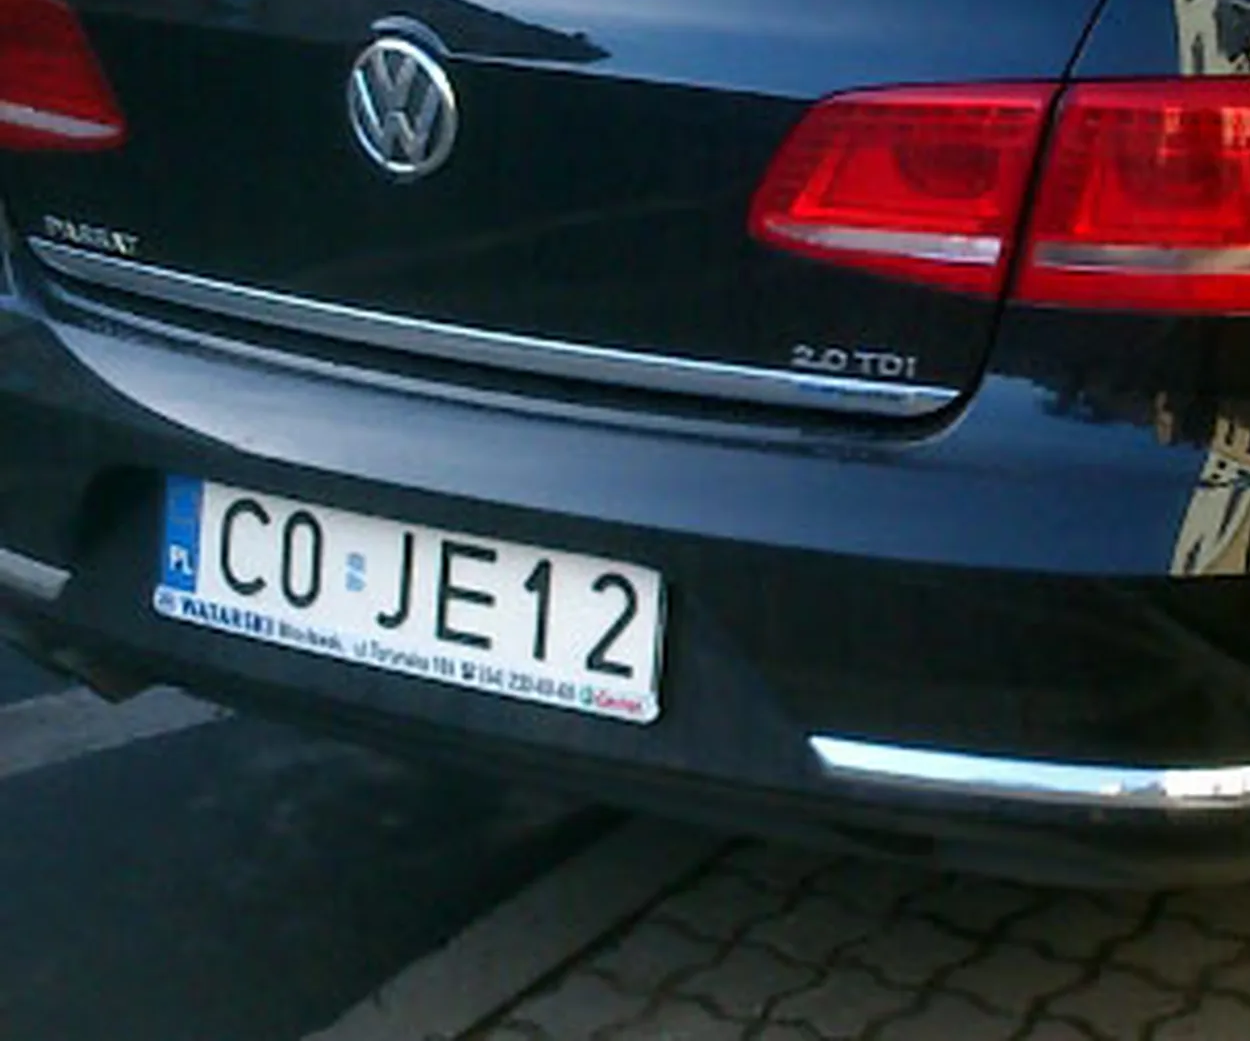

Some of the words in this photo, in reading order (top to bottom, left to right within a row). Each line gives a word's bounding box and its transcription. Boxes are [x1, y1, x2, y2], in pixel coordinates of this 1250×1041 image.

[854, 352, 917, 379] TDI
[170, 544, 194, 575] PL
[376, 531, 638, 679] JE12
